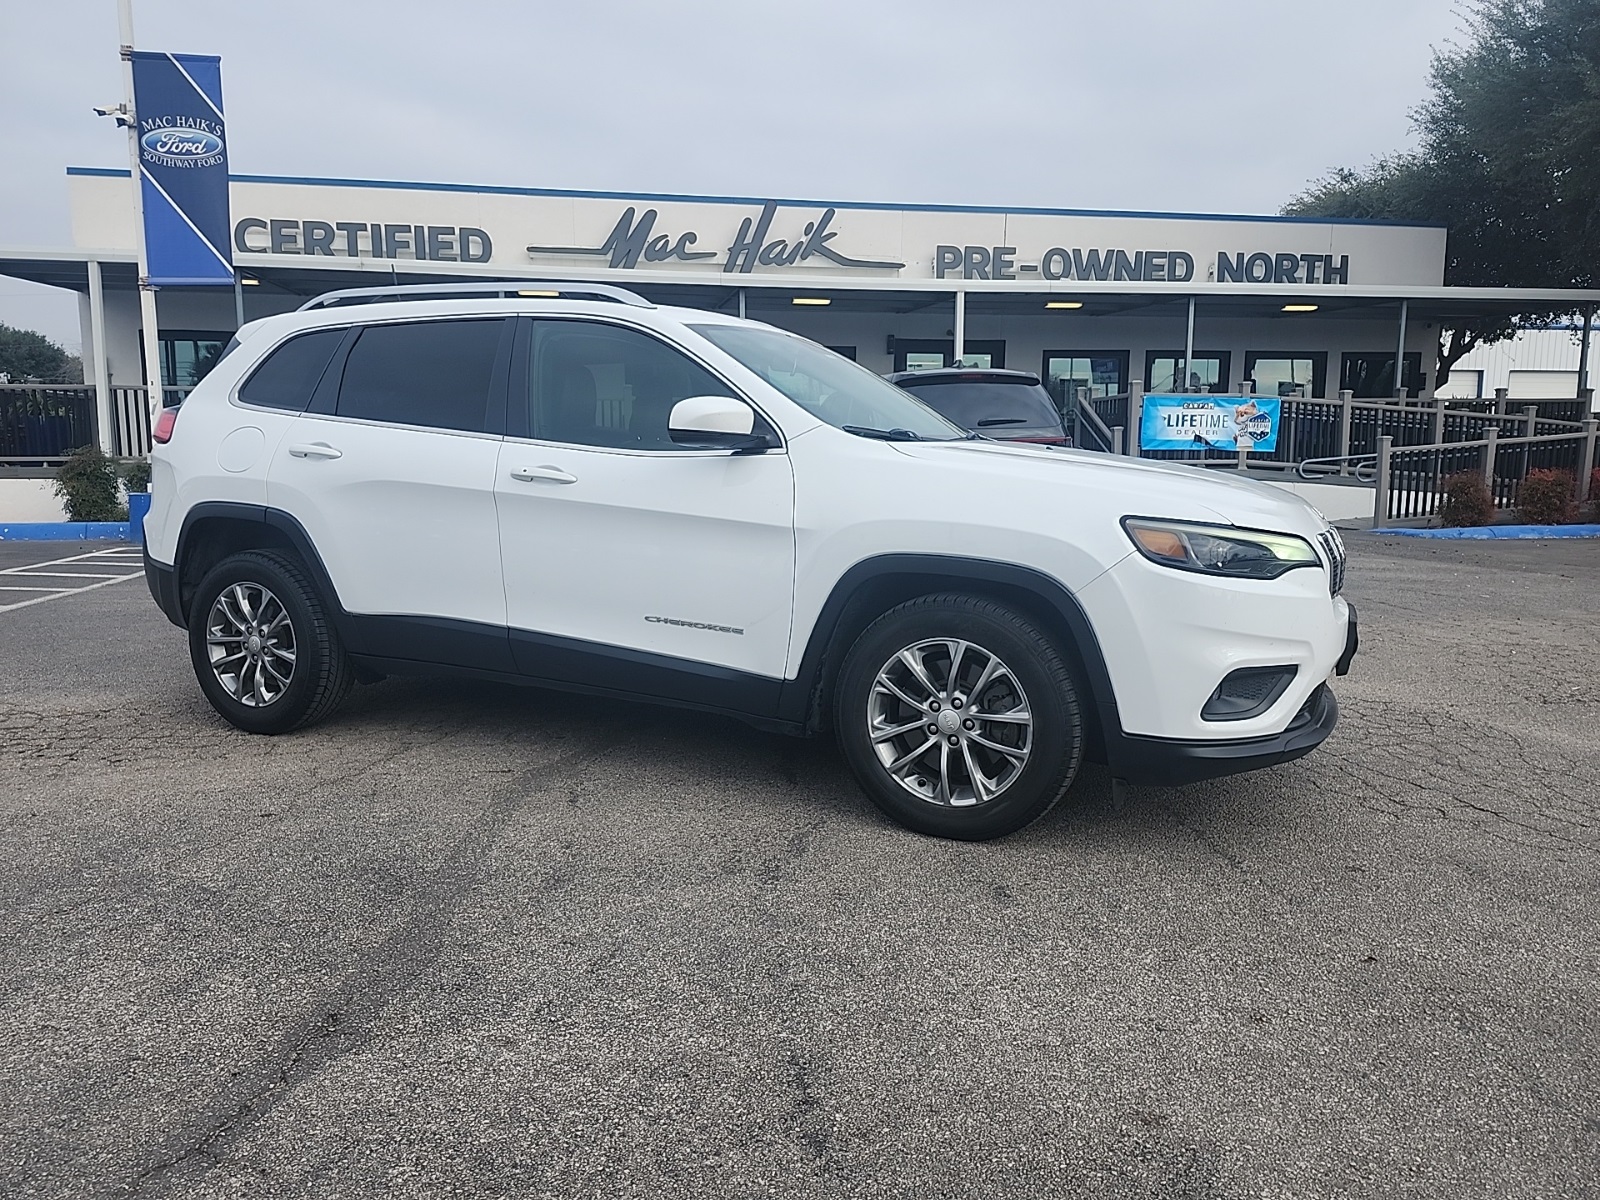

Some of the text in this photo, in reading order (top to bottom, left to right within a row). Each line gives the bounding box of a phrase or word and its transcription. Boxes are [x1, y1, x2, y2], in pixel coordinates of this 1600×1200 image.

[141, 116, 223, 136] MAC HAIK'S
[157, 132, 207, 154] Ford
[142, 152, 224, 168] SOUTHWAY FORD
[234, 217, 493, 264] CERTIFIED
[526, 200, 906, 273] Mac Haik
[936, 245, 1350, 284] PRE-OWNED NORTH
[1166, 413, 1229, 429] LIFETIME
[644, 616, 744, 635] CHEROKEE
